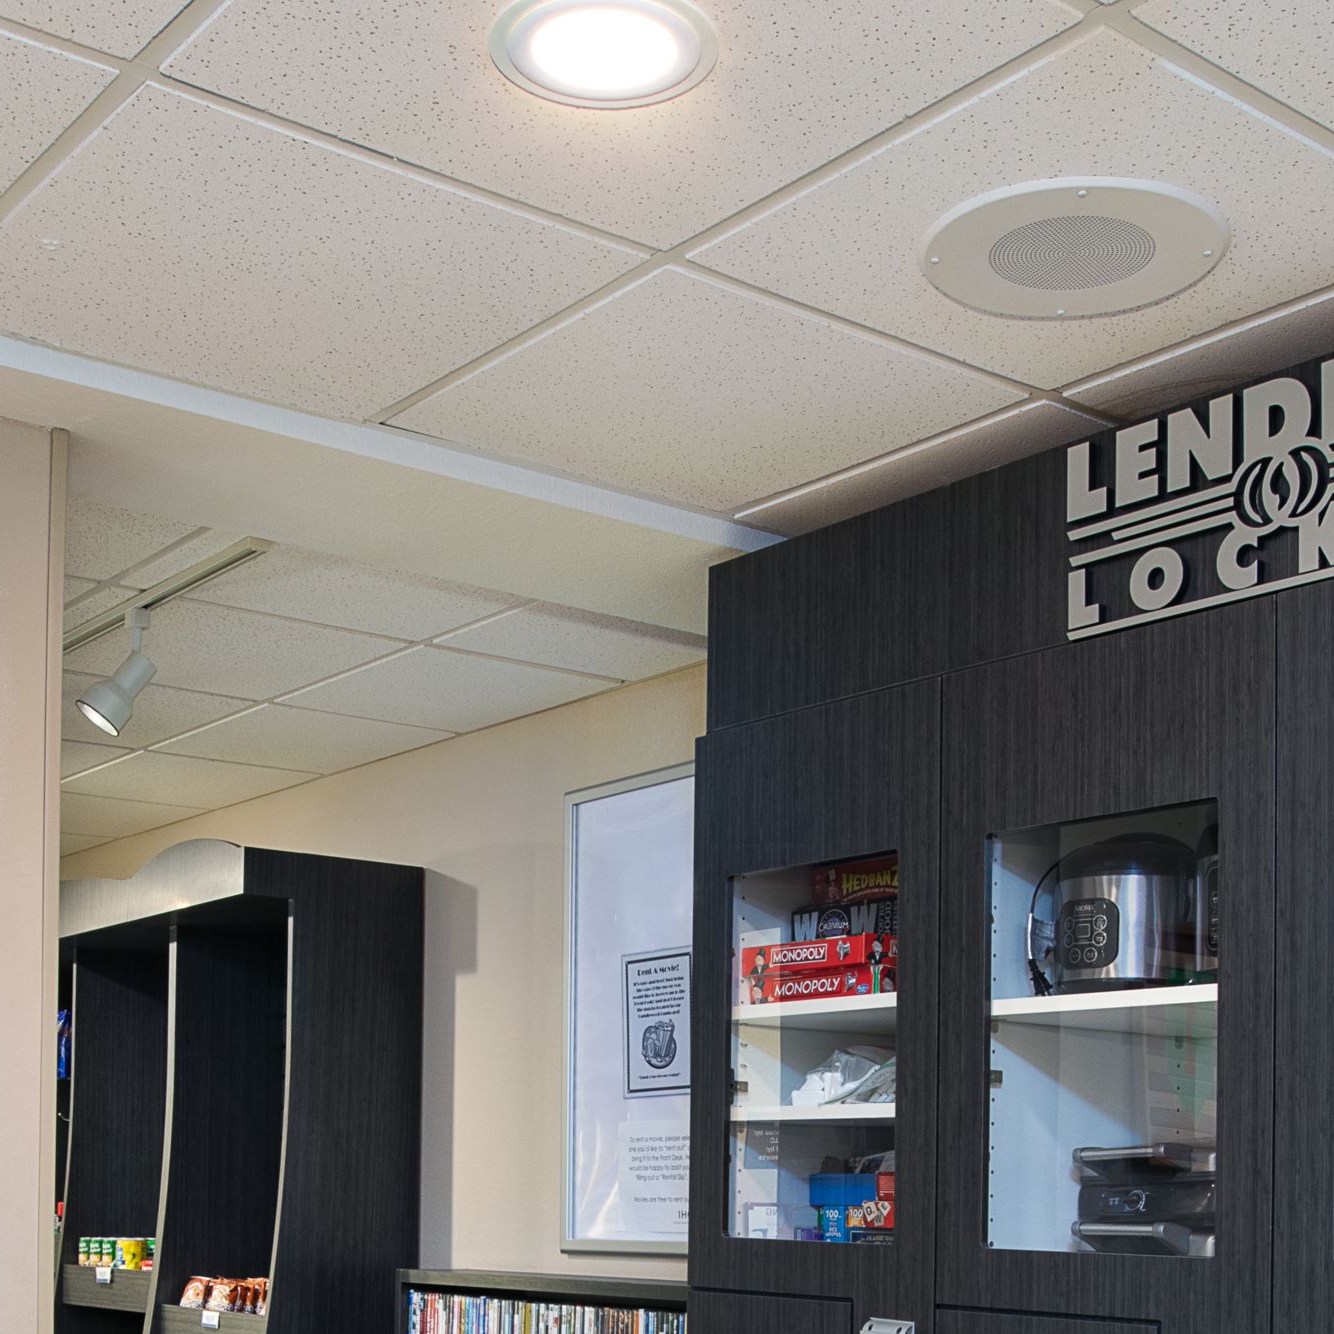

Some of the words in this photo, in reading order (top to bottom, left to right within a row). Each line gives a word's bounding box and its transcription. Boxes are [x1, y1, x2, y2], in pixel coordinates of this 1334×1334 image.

[772, 947, 826, 963] MONOPOLY
[774, 977, 841, 997] MONOPOLY
[678, 1209, 689, 1219] IH
